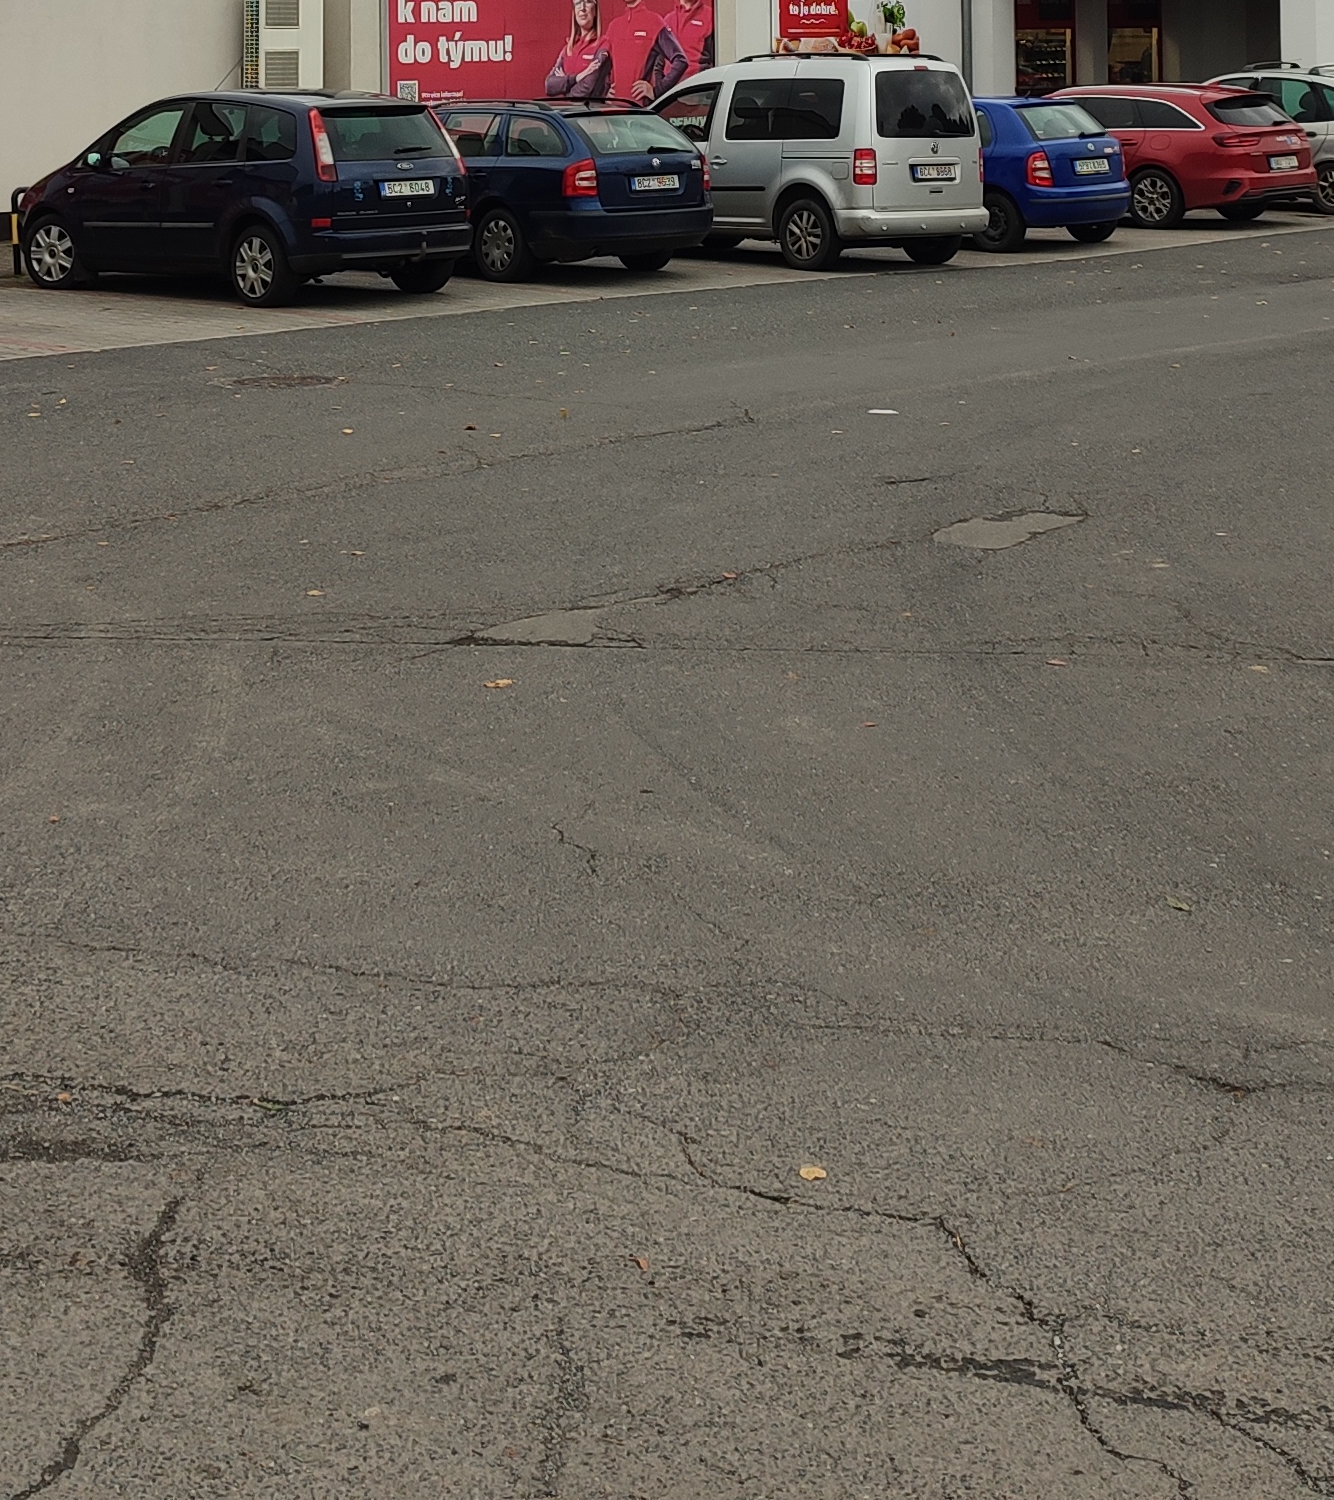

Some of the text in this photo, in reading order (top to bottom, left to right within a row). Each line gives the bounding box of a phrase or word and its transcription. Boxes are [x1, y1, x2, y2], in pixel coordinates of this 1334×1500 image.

[789, 1, 838, 17] to je dobré.
[398, 32, 513, 68] do týmu!
